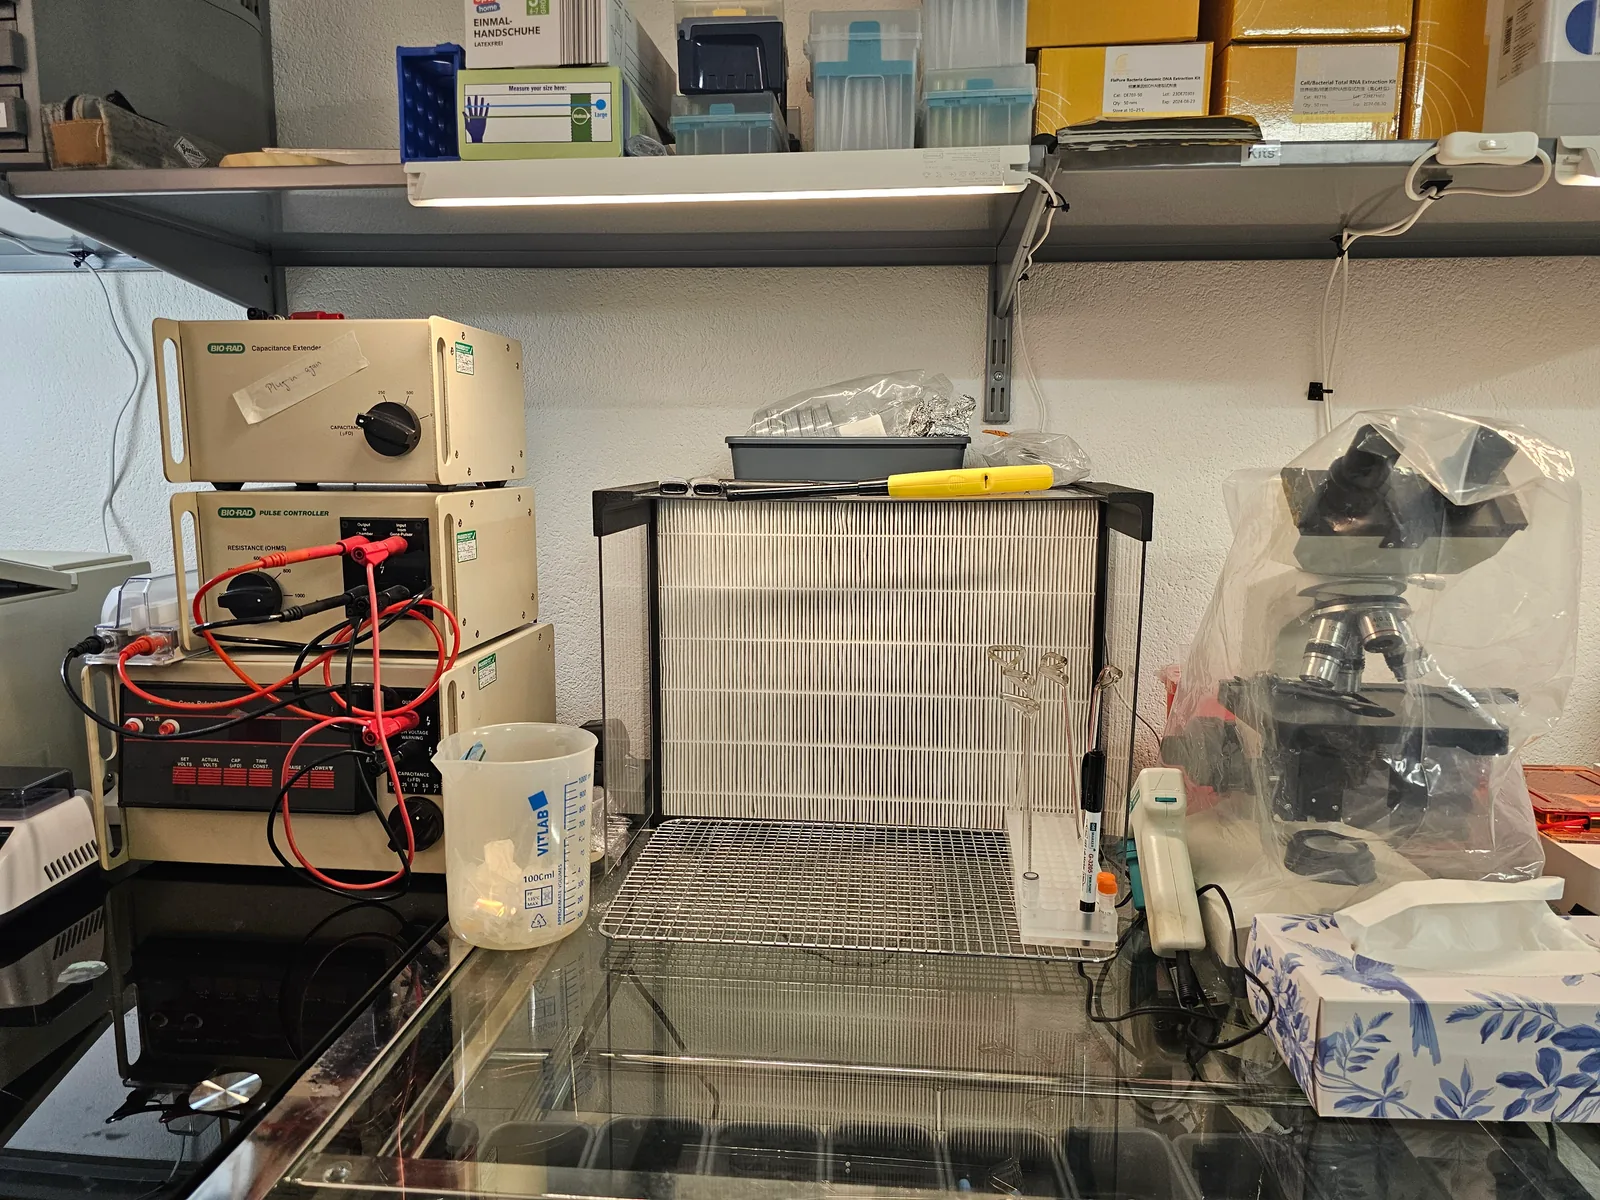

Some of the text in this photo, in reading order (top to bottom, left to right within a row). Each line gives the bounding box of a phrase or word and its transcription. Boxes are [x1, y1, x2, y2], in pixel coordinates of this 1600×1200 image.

[473, 18, 512, 27] EINMAL-
[473, 26, 541, 38] HANDSCHUHE
[594, 111, 608, 119] Large
[1248, 146, 1276, 159] Kits
[537, 809, 549, 857] VITLAB
